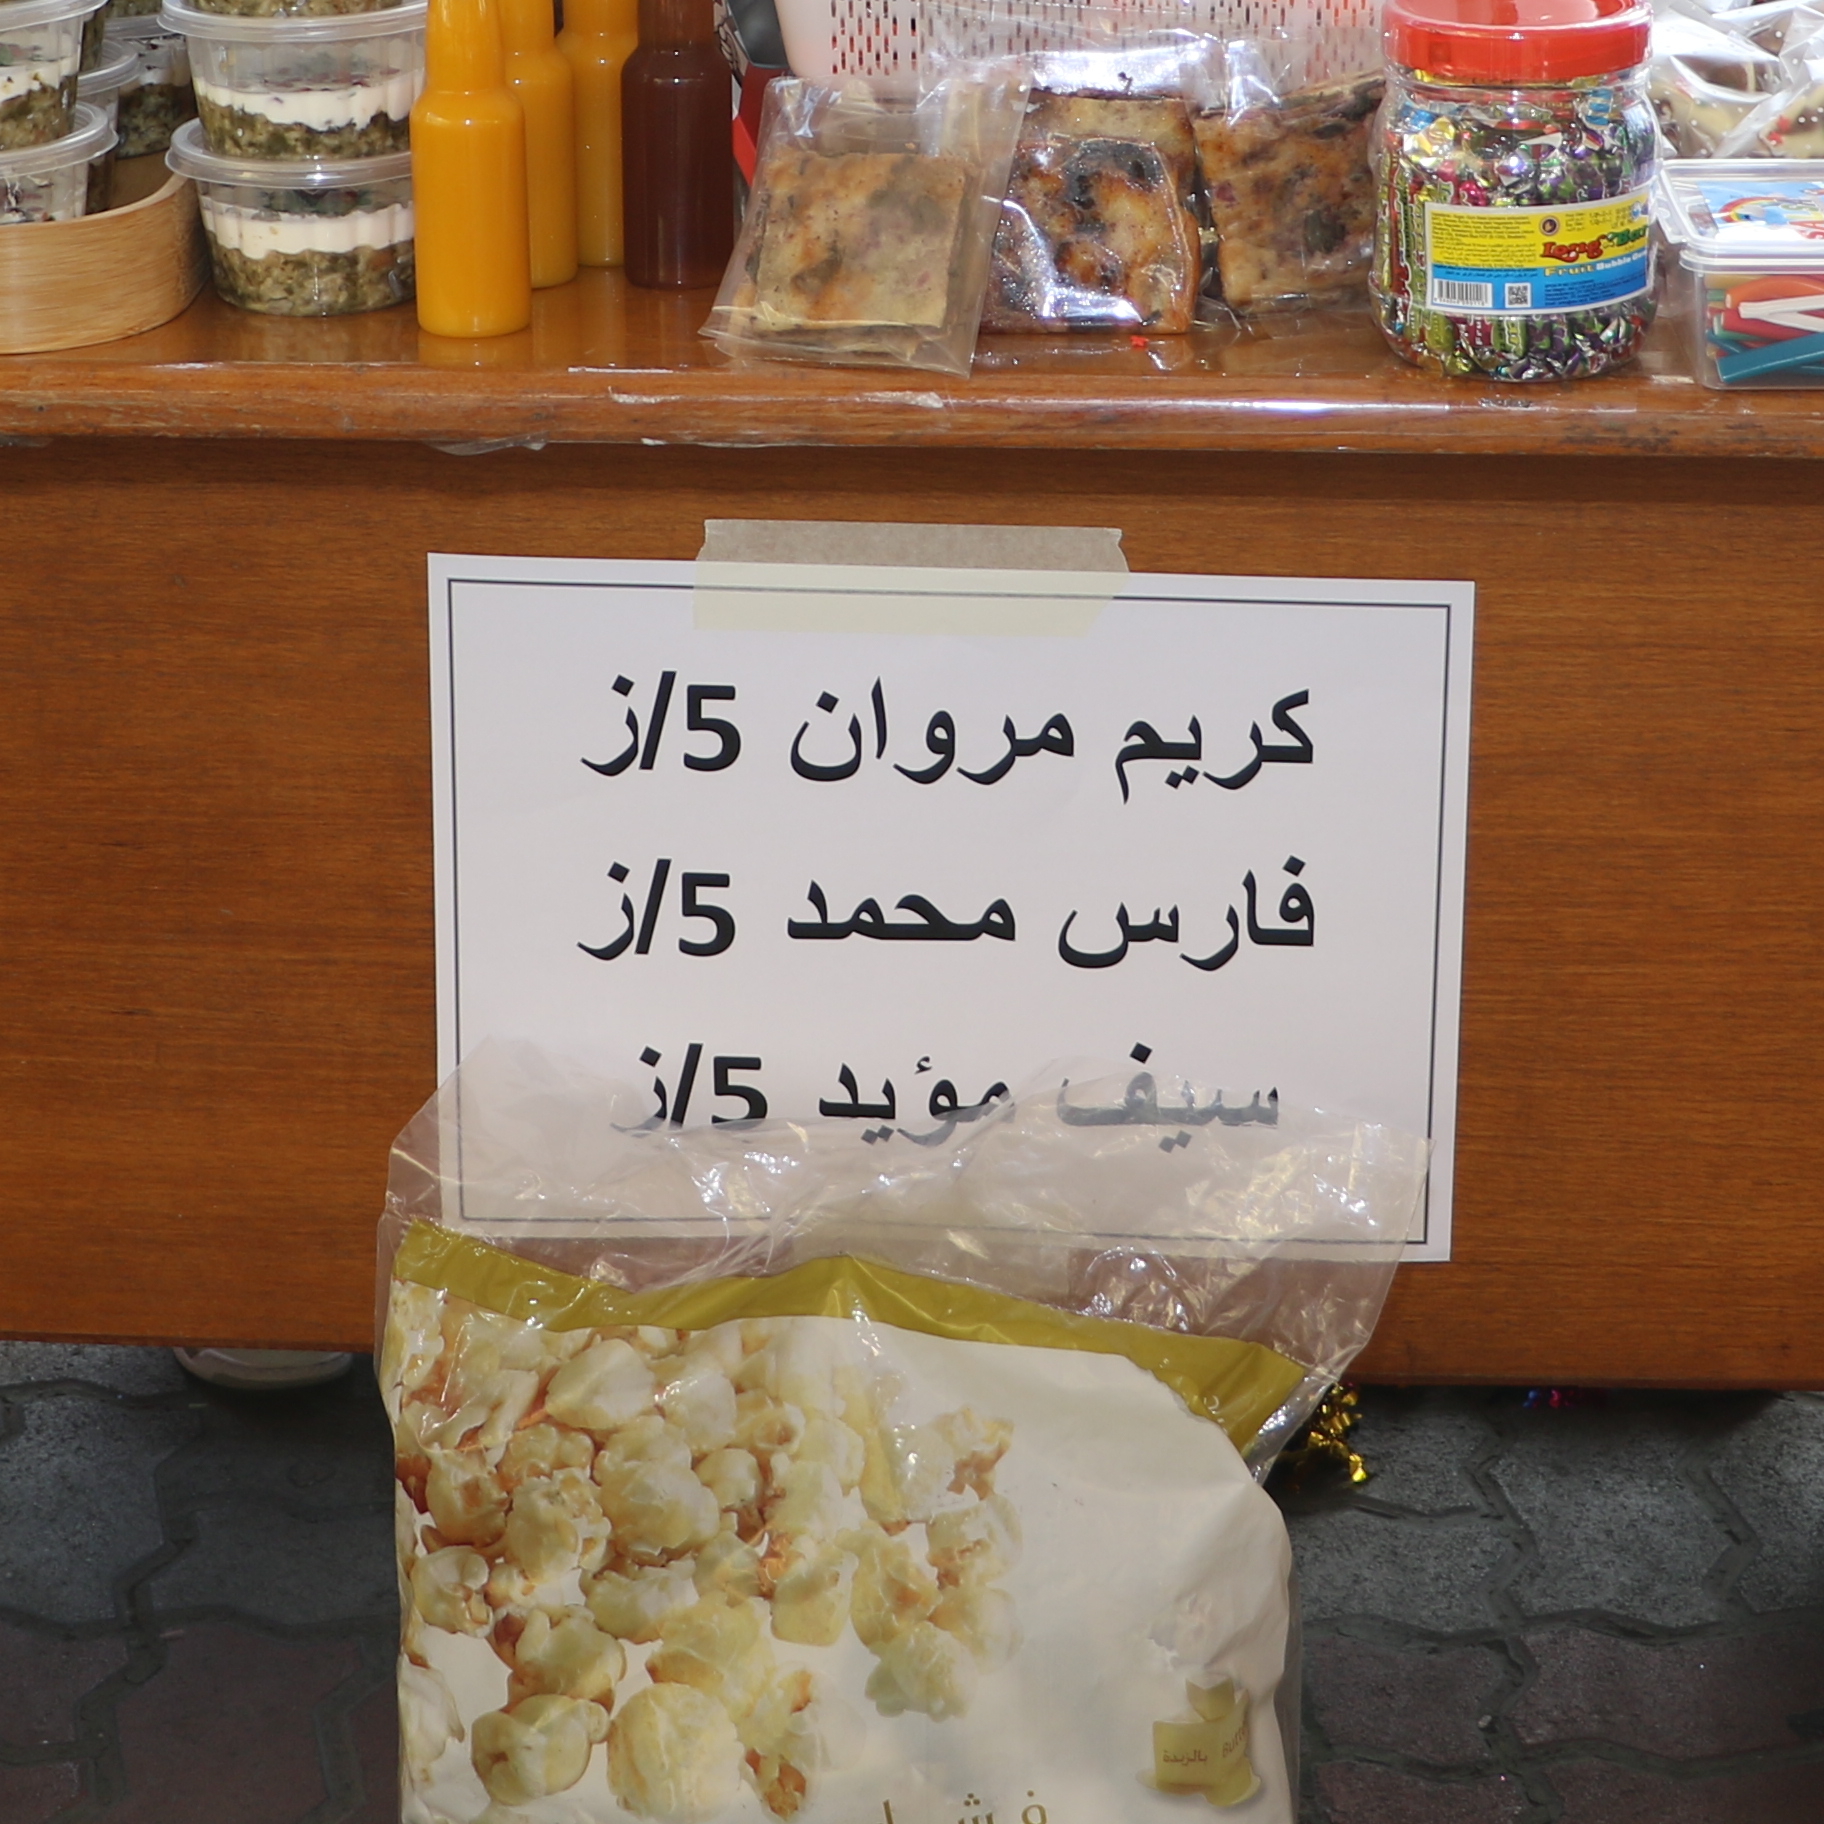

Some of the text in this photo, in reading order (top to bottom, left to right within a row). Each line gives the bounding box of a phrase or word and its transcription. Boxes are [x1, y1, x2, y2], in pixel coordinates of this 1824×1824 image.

[1545, 264, 1594, 277] Fruit
[1596, 256, 1631, 271] Bubble
[788, 677, 1075, 785] مروان
[1116, 689, 1314, 804] كريم
[787, 876, 1015, 942] محمد
[1057, 853, 1314, 970] فارس
[818, 1053, 1019, 1147] مؤيد
[1057, 1040, 1280, 1153] سيف
[1163, 1749, 1208, 1767] بالزبدة
